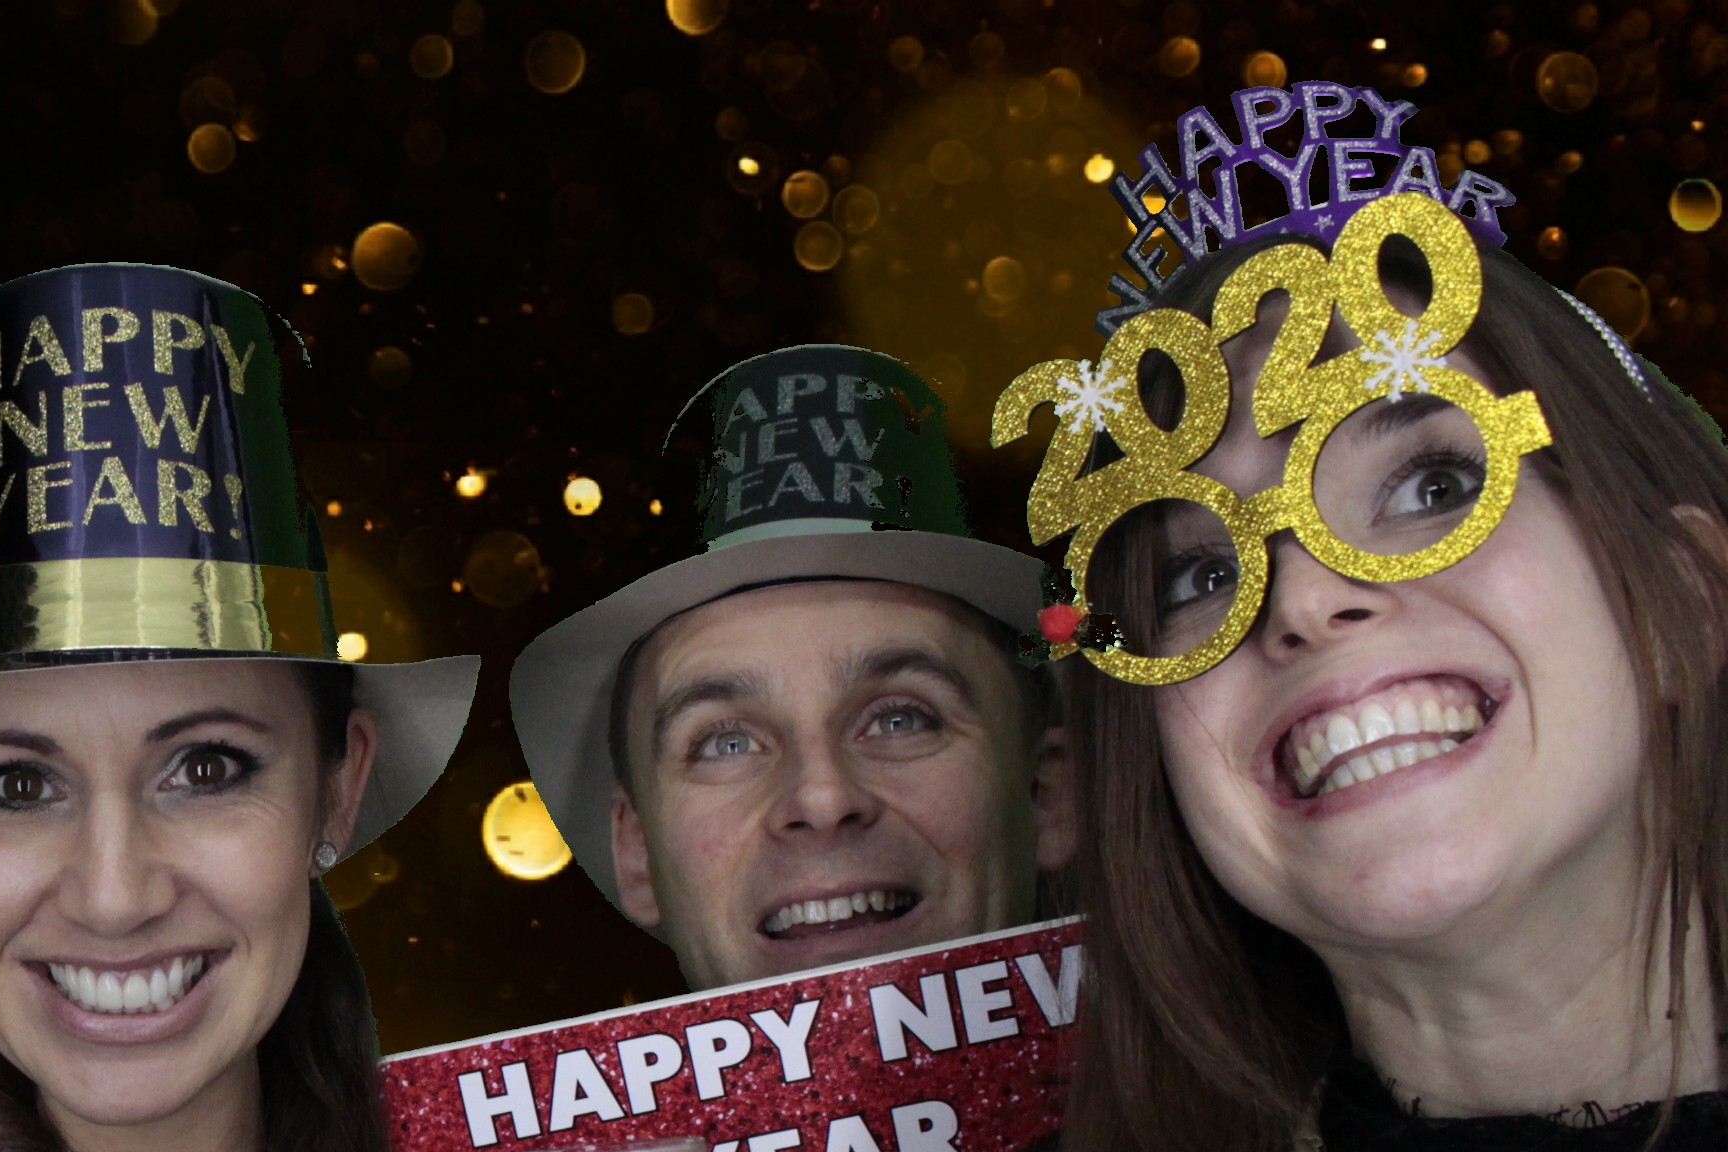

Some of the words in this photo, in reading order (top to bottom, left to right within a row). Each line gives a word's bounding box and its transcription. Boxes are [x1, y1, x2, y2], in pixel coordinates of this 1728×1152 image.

[1098, 168, 1236, 337] NEW
[1258, 141, 1516, 223] YEAR
[1115, 83, 1416, 222] HAPPY
[990, 192, 1484, 548] 2020
[456, 999, 824, 1149] HAPPY
